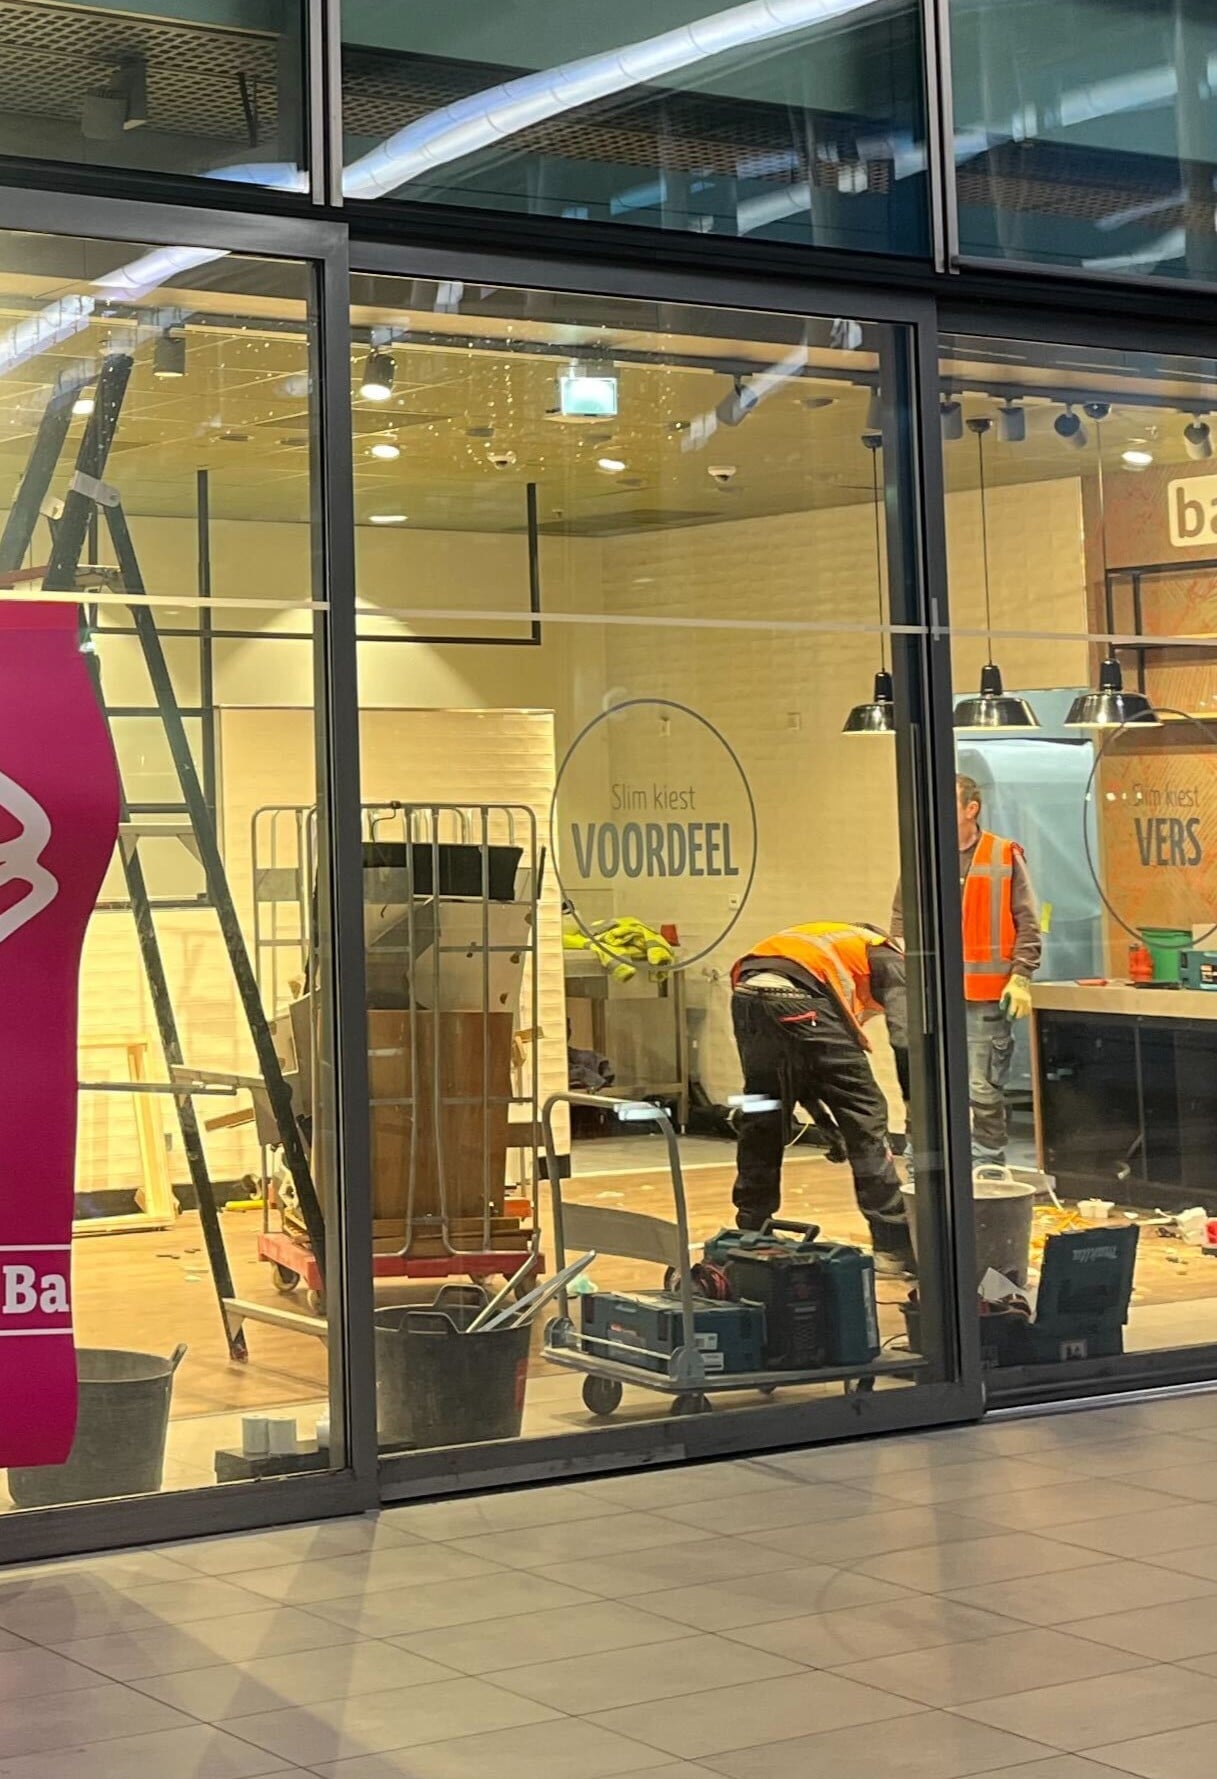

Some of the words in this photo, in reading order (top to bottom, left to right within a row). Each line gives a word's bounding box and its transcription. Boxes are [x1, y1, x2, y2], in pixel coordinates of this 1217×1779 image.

[611, 783, 647, 810] Slim
[653, 784, 696, 810] kiest
[1165, 783, 1200, 808] kiest
[571, 822, 739, 878] VOORDEEL
[1134, 817, 1202, 866] VERS
